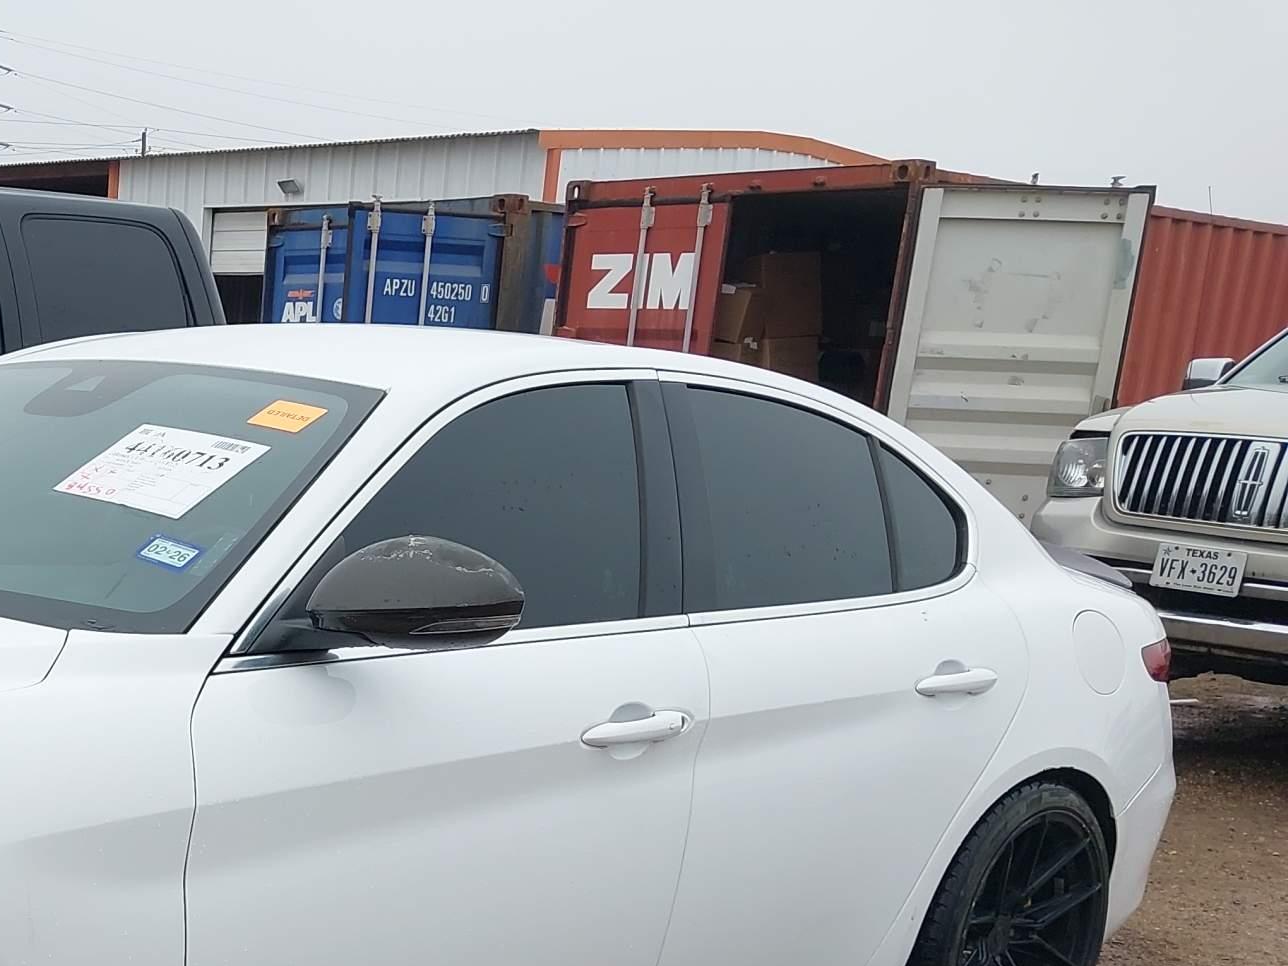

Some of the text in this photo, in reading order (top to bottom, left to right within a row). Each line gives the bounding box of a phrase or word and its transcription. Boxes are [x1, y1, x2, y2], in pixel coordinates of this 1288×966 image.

[383, 278, 489, 302] APZU 450250 0
[587, 253, 696, 310] ZIM
[281, 302, 317, 323] APL
[427, 305, 456, 323] 42G1
[267, 409, 311, 422] DETAILED
[125, 441, 230, 471] 44160713
[1186, 548, 1219, 560] TEXAS
